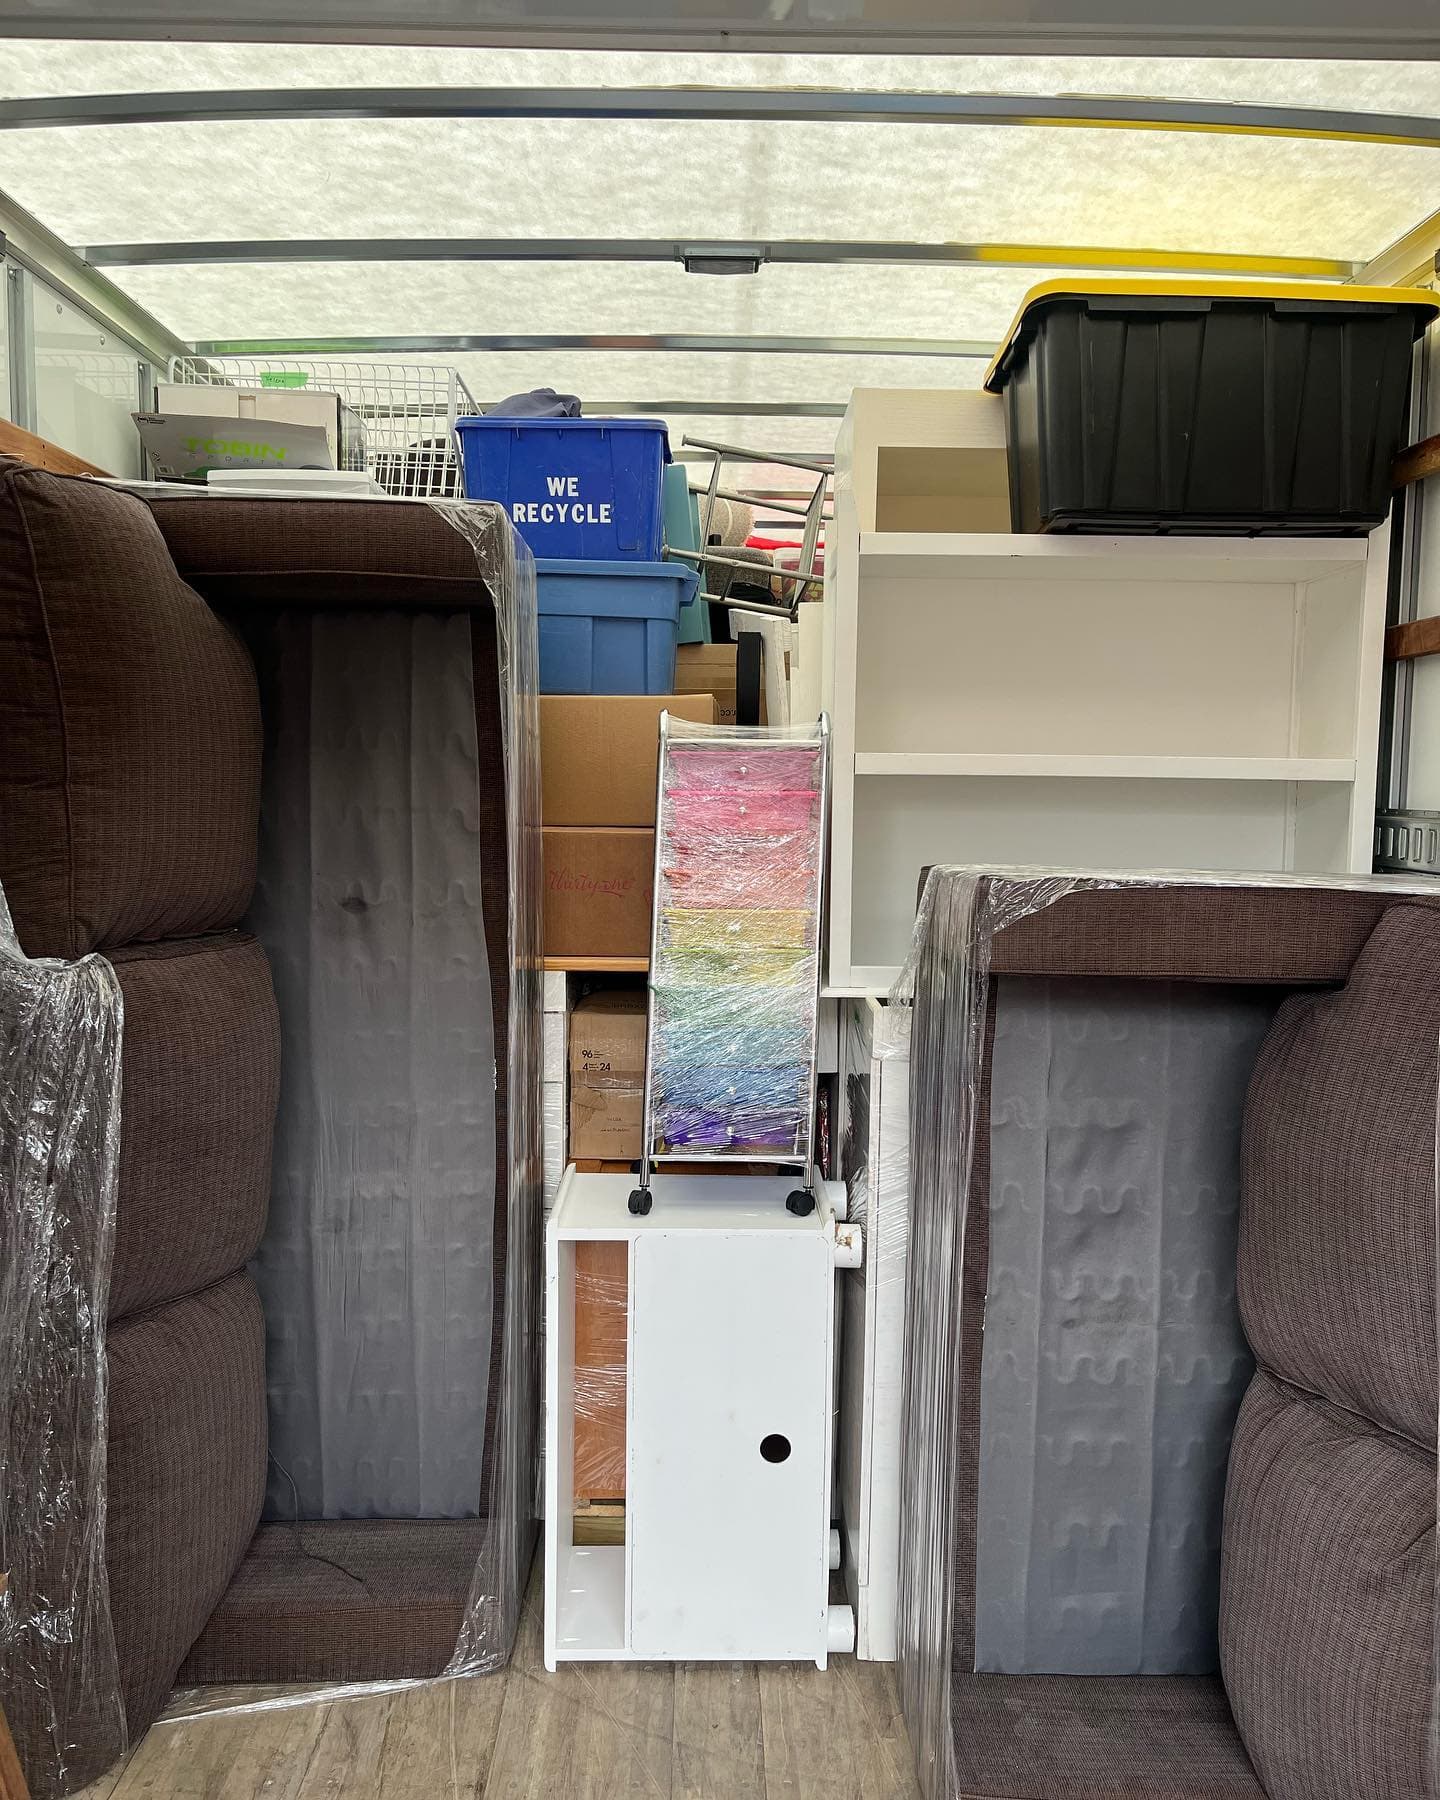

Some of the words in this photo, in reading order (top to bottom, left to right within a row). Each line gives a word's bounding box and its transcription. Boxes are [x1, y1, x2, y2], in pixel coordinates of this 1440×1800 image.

[183, 437, 288, 459] TOBIN
[546, 477, 579, 497] WE
[512, 503, 612, 524] RECYCLE
[581, 1049, 593, 1059] 96
[582, 1062, 589, 1071] 4
[599, 1062, 611, 1071] 24
